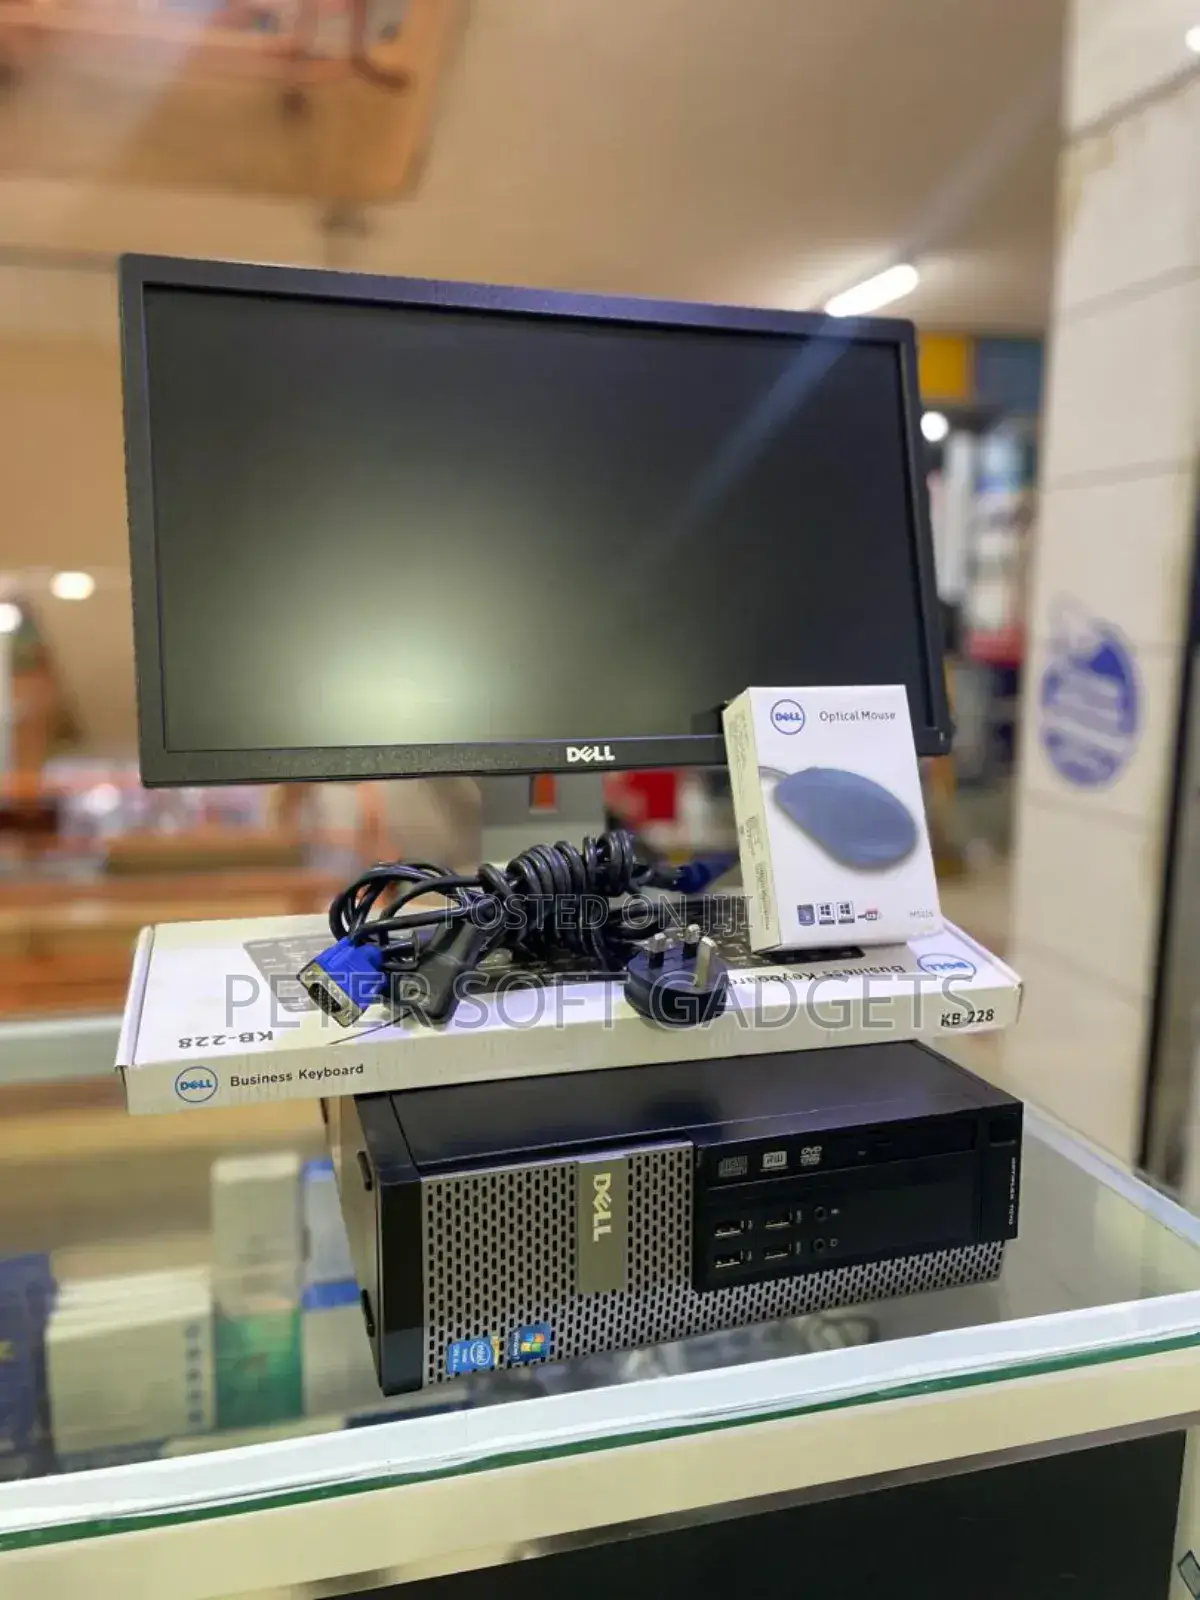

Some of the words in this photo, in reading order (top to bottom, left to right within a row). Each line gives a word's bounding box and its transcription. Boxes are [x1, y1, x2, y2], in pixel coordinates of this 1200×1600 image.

[775, 712, 802, 722] DELL
[819, 710, 860, 722] Optical
[861, 710, 896, 721] Mouse
[566, 745, 616, 763] DELL
[822, 963, 906, 979] Business
[178, 1030, 274, 1049] KB-228
[230, 1072, 294, 1088] Business
[297, 1063, 364, 1083] Keyboard
[179, 1079, 214, 1092] DELL
[592, 1173, 613, 1243] DELL
